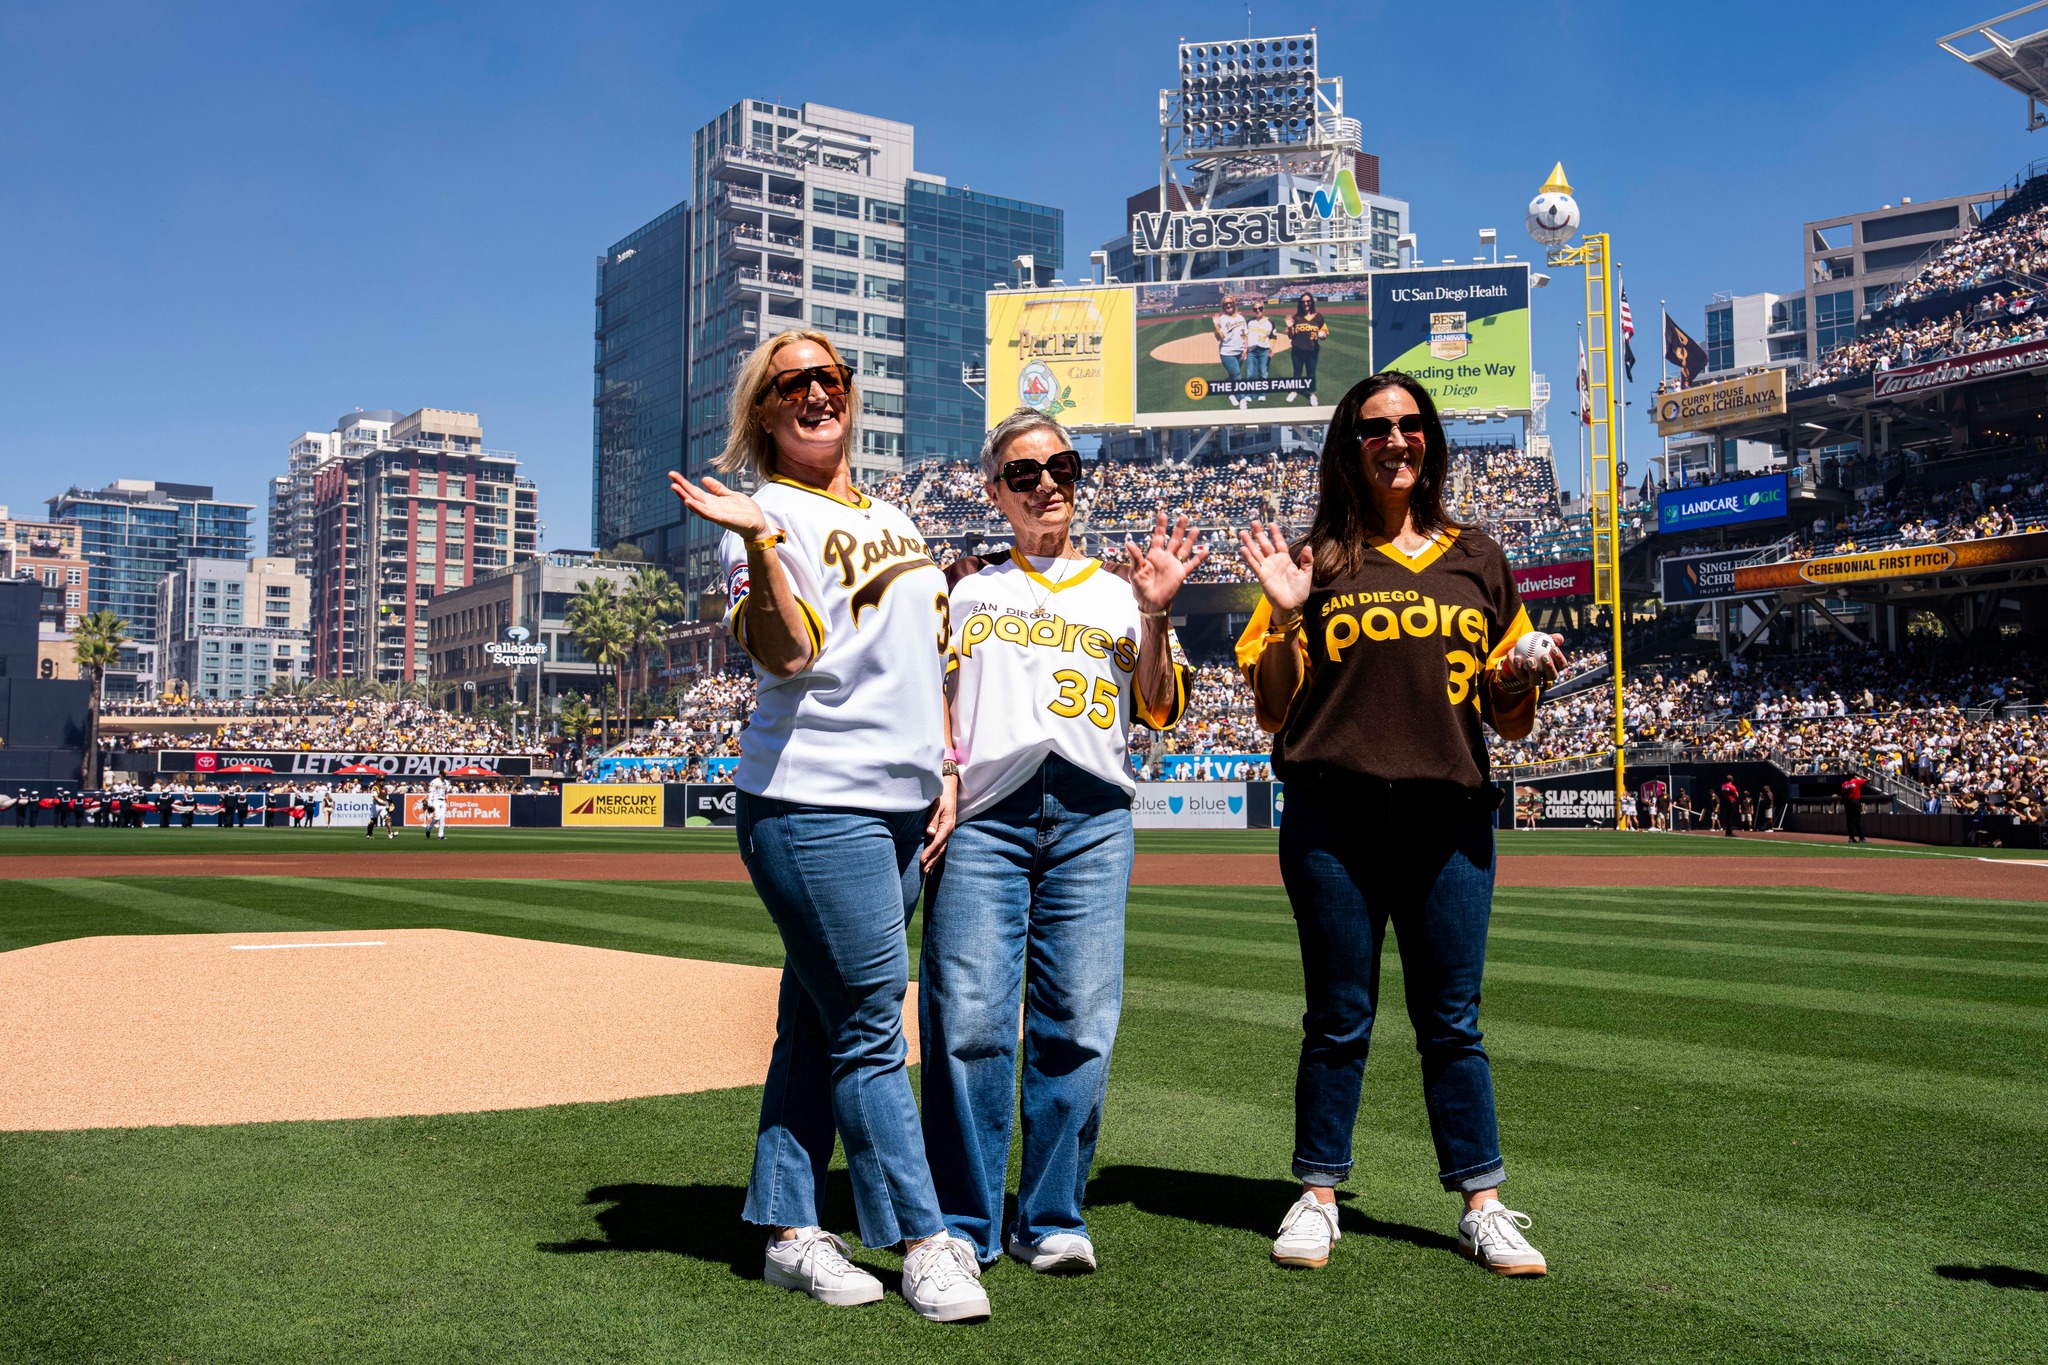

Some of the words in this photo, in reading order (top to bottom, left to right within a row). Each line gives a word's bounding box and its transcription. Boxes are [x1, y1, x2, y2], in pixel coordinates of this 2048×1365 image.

[1139, 203, 1296, 251] Viasat
[1392, 289, 1411, 302] UC
[1412, 288, 1434, 301] San
[1435, 286, 1468, 301] Diego
[1469, 284, 1508, 298] Health
[1432, 314, 1464, 325] BEST
[1457, 365, 1481, 378] the
[1485, 363, 1516, 378] Way
[1876, 362, 1969, 396] Tarantino
[1971, 348, 2048, 377] SAUSAGES
[1210, 383, 1232, 393] THE
[1234, 381, 1269, 392] JONES
[1271, 379, 1312, 390] FAMILY
[1443, 384, 1478, 398] Diego
[1681, 392, 1710, 408] CURRY
[1712, 386, 1744, 400] HOUSE
[1681, 404, 1710, 418] CoCo
[1713, 389, 1777, 412] ICHIBANYA
[1681, 496, 1739, 515] LANDCARE
[1807, 559, 1876, 576] CEREMONIAL
[1879, 556, 1911, 570] FIRST
[1914, 552, 1949, 567] PITCH
[1700, 587, 1723, 595] INJURY
[972, 602, 998, 615] SAN
[1006, 607, 1051, 620] DIEGO
[1321, 597, 1355, 617] SAN
[1358, 590, 1419, 604] DIEGO
[485, 642, 547, 655] Gallagher
[961, 614, 1137, 673] padres
[493, 653, 538, 666] Square
[41, 658, 53, 678] 9
[1047, 669, 1120, 729] 35
[221, 757, 273, 767] TOYOTA
[292, 754, 354, 774] LET'S
[360, 755, 400, 775] GO
[596, 795, 657, 806] MERCURY
[1190, 797, 1226, 810] blue
[1545, 790, 1578, 805] SLAP
[474, 808, 501, 818] Park
[596, 806, 657, 815] INSURANCE
[1545, 805, 1586, 819] CHEESE
[1587, 805, 1604, 818] ON
